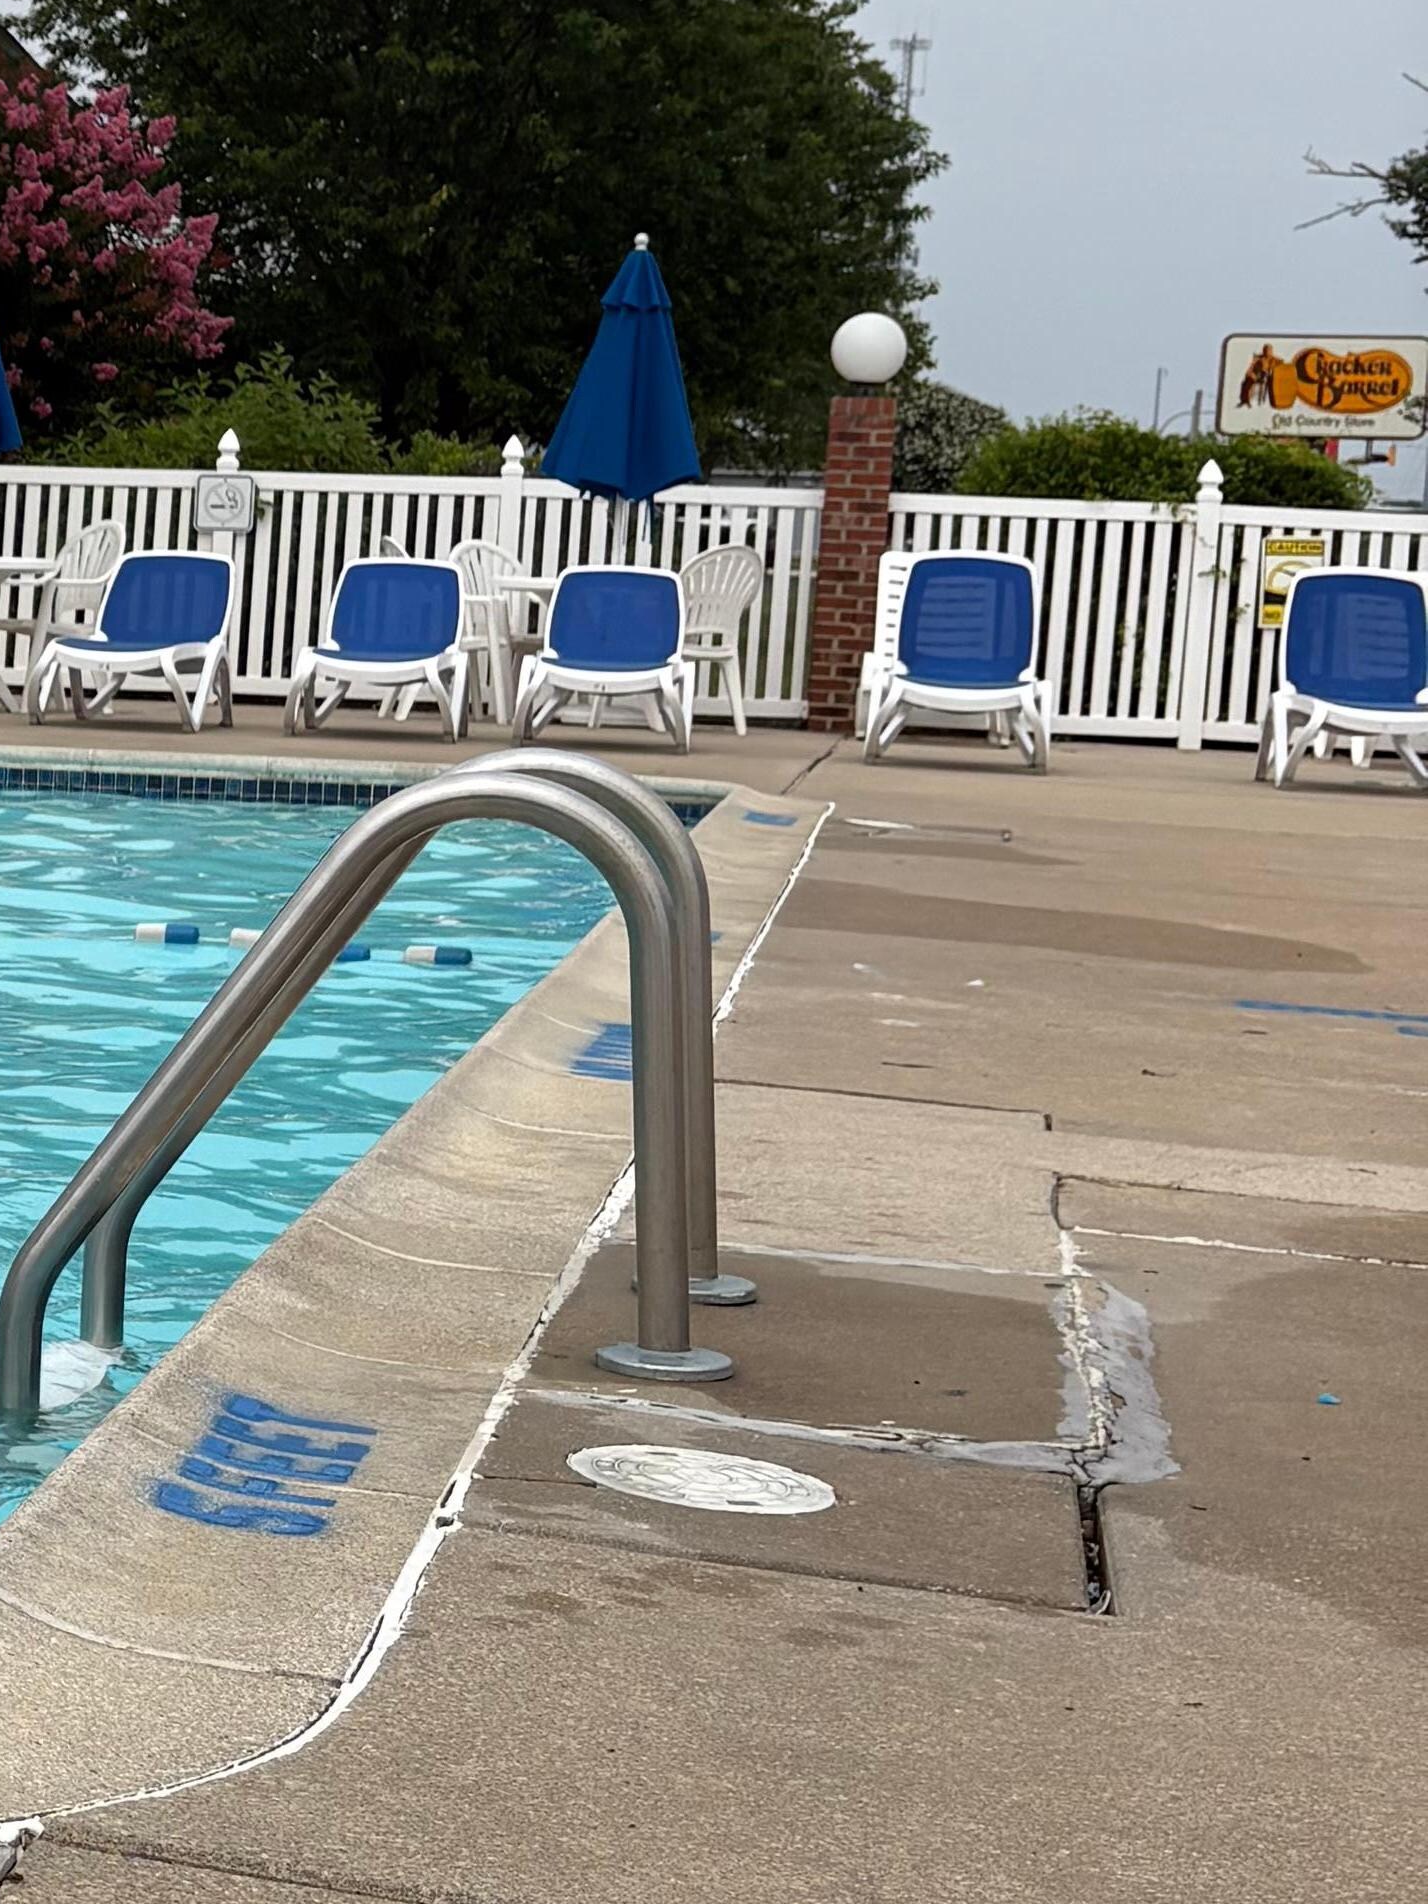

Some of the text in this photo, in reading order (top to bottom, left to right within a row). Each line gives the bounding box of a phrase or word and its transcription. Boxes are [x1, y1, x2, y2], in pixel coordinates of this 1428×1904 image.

[1295, 348, 1392, 384] Cracker
[1316, 377, 1400, 409] Barrel
[1272, 414, 1375, 429] Old Country Store
[176, 1392, 378, 1508] FEET
